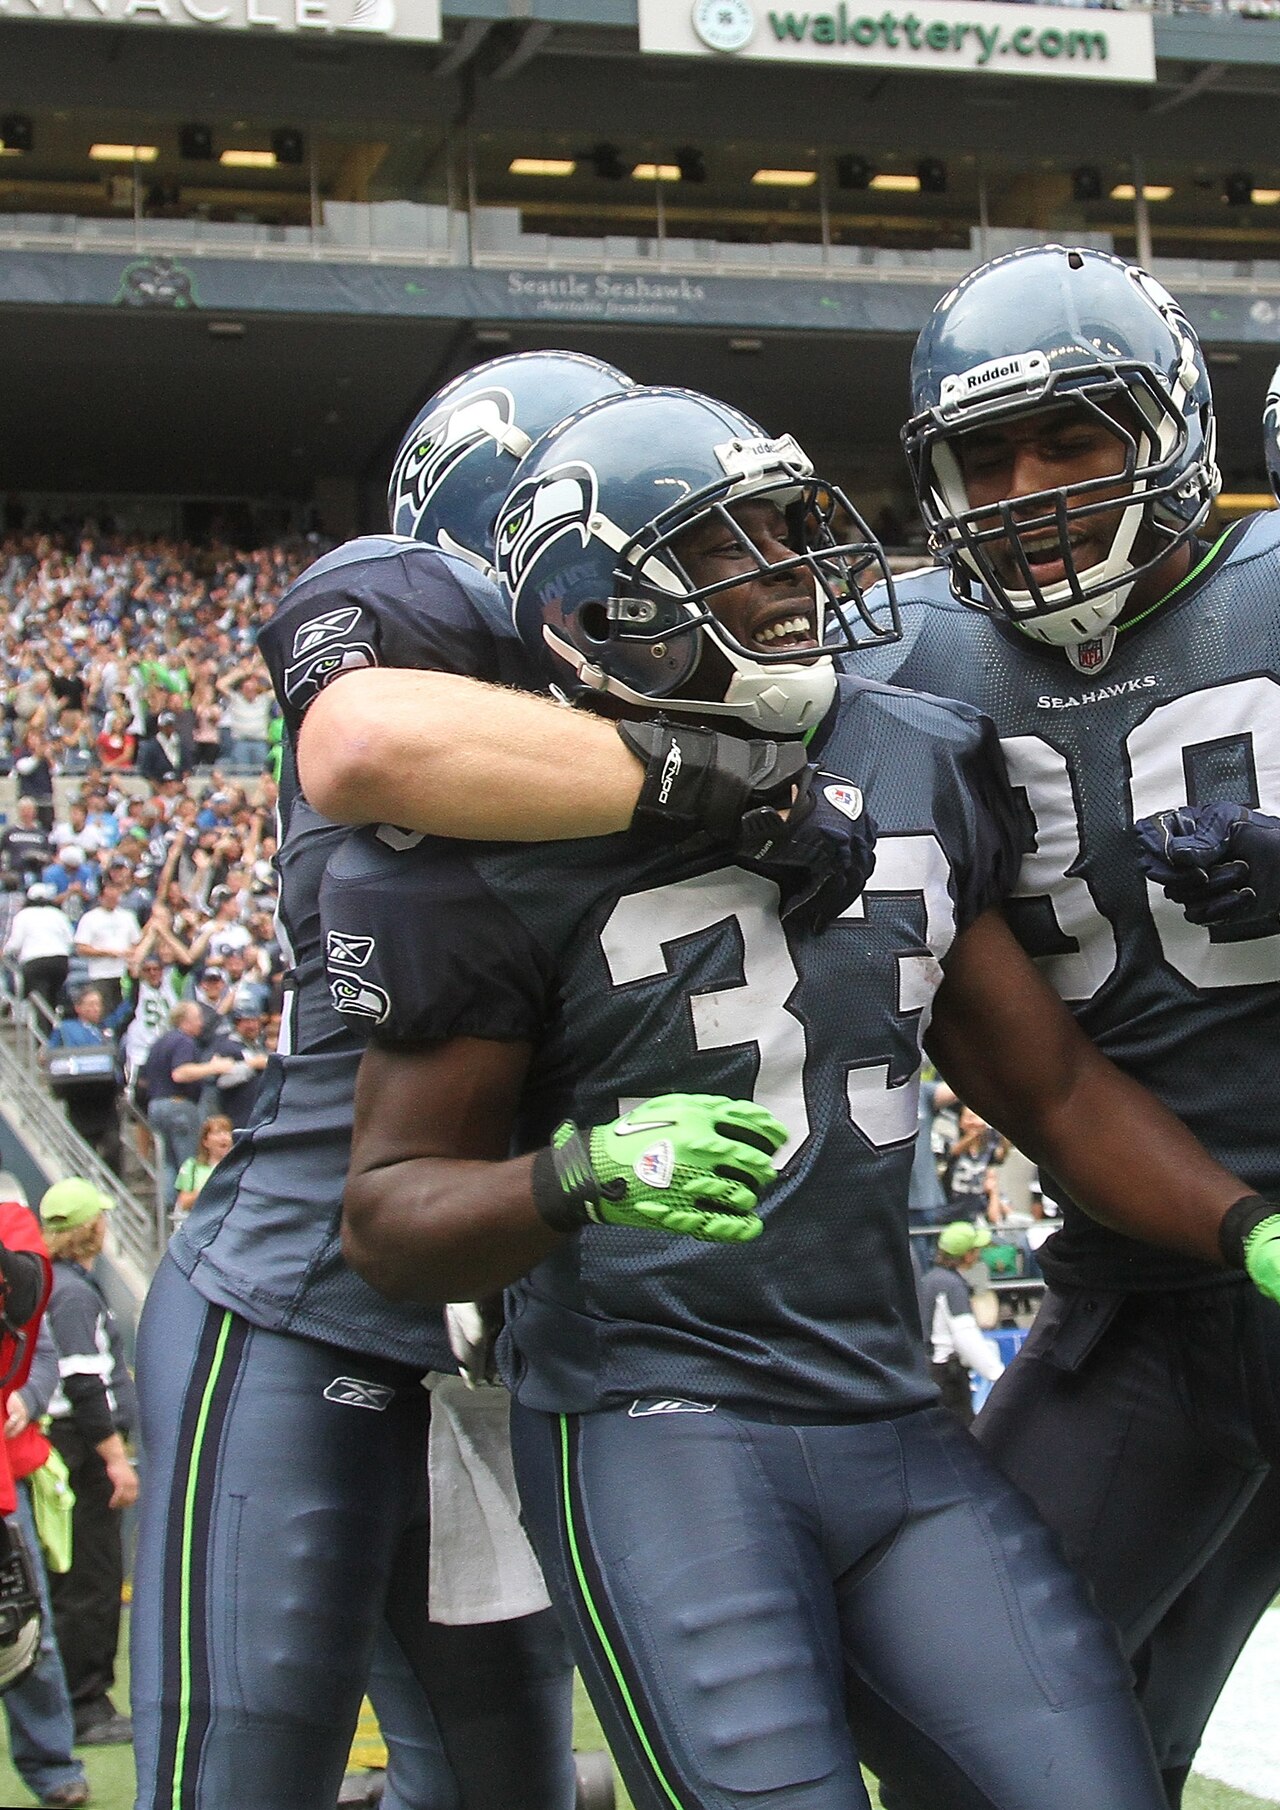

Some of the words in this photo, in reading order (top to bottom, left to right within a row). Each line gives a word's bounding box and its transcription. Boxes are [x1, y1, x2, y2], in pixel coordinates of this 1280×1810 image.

[767, 1, 1110, 65] walottery.com
[508, 271, 590, 297] Seattle
[595, 274, 705, 300] Seahawks
[966, 360, 1021, 389] Riddell
[1036, 674, 1158, 710] SEAHAWKS
[599, 834, 958, 1170] 33
